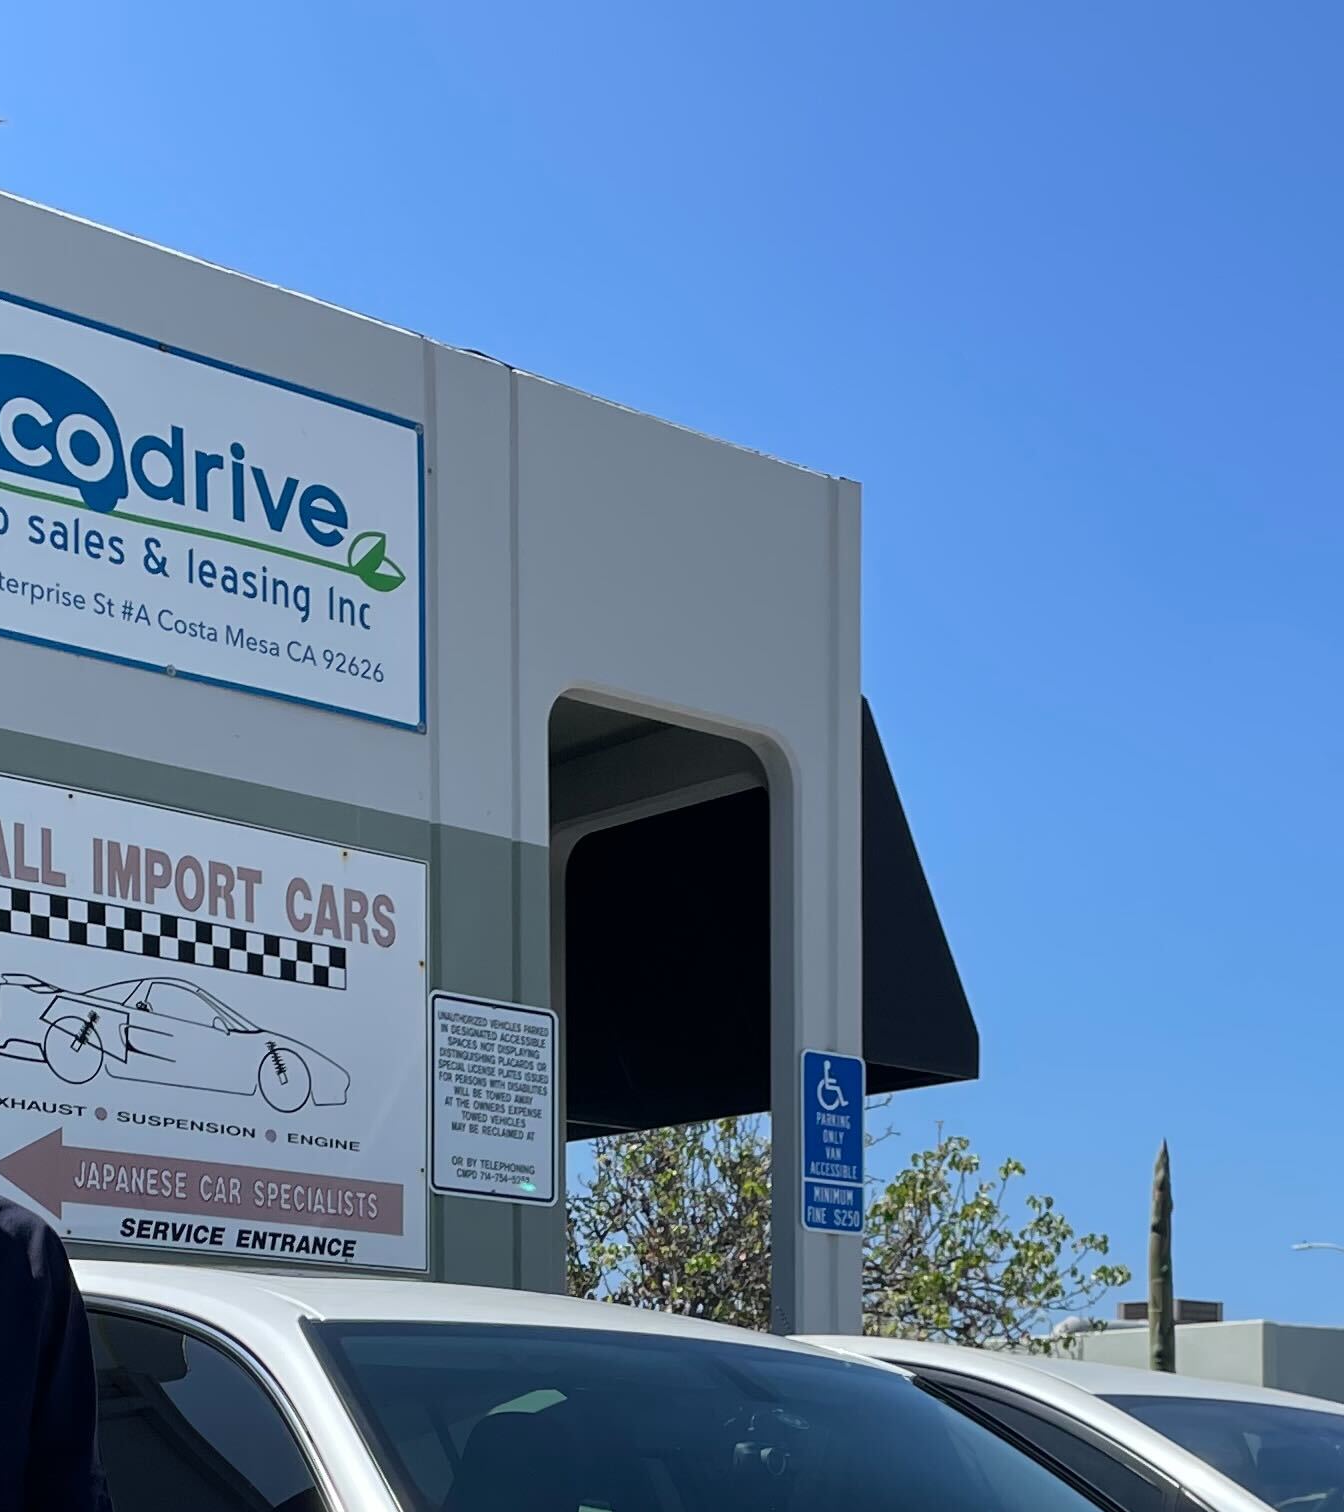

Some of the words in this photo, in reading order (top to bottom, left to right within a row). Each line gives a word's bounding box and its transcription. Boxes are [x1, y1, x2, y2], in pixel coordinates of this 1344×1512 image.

[27, 514, 125, 566] sales
[143, 536, 170, 577] &
[187, 548, 311, 624] leasing
[327, 585, 371, 631] Inc
[93, 592, 117, 620] St
[121, 598, 152, 628] #A
[157, 609, 219, 644] Costa
[224, 626, 281, 659] Mesa
[286, 639, 318, 667] CA
[322, 648, 385, 684] 92626
[92, 837, 263, 923] IMPORT
[285, 876, 397, 949] CARS
[816, 1111, 851, 1129] PARKING
[116, 1110, 256, 1139] SUSPENSION
[287, 1131, 361, 1152] ENGINE
[822, 1129, 845, 1145] ONLY
[451, 1155, 463, 1166] OR
[825, 1147, 842, 1161] VAN
[809, 1160, 857, 1180] ACCESSIBLE
[74, 1159, 188, 1200] JAPANESE
[199, 1171, 241, 1205] CAR
[254, 1179, 378, 1219] SPECIALISTS
[813, 1185, 854, 1206] MINIMUM
[807, 1205, 827, 1225] FINE
[120, 1217, 227, 1247] SERVICE
[236, 1229, 357, 1259] ENTRANCE
